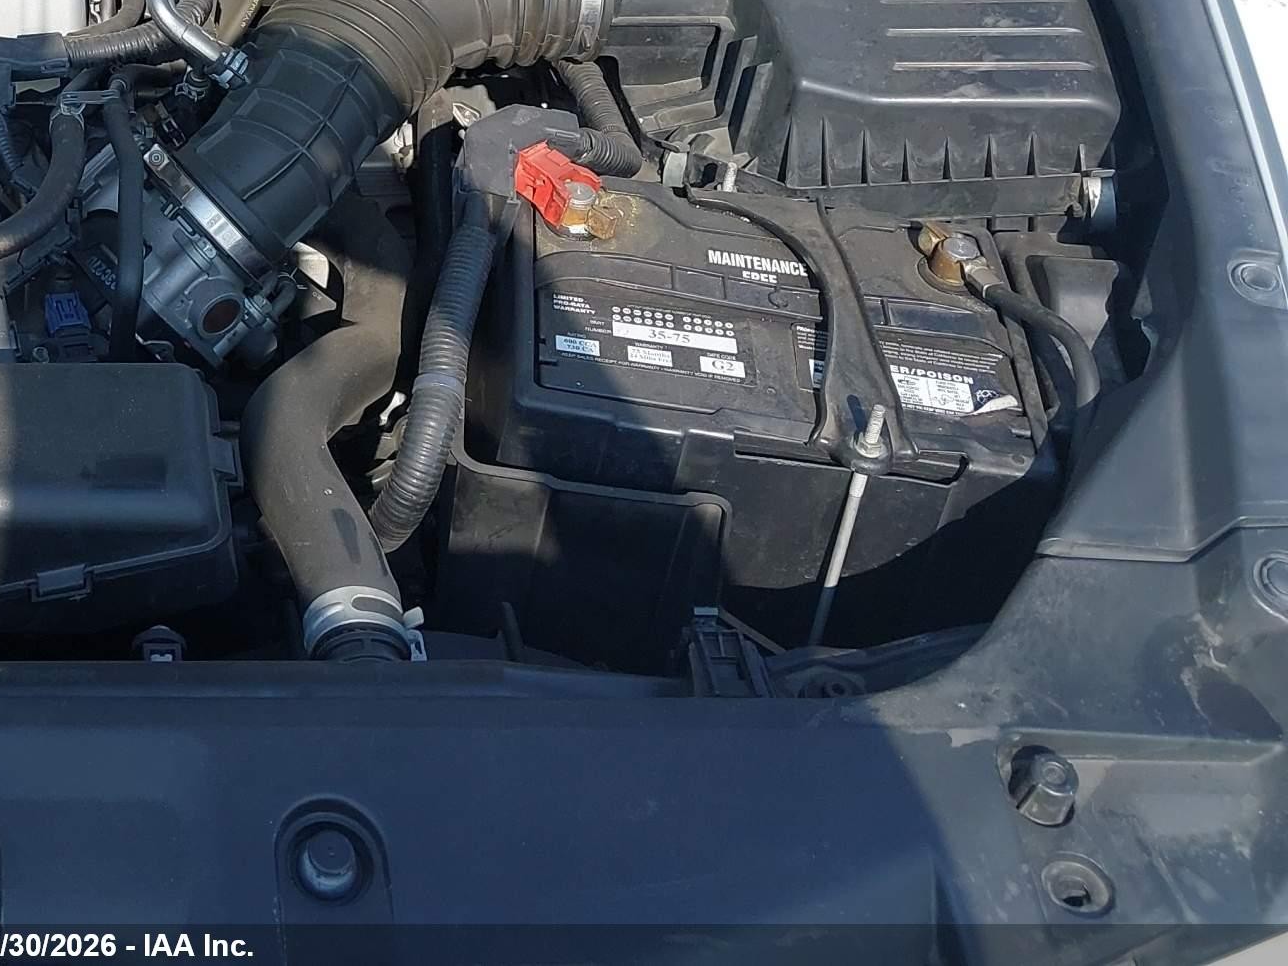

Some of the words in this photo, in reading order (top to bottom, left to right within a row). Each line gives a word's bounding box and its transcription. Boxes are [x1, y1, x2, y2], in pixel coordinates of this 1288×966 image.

[707, 249, 808, 277] MAINTENANCE
[647, 329, 691, 344] 35-75
[711, 359, 736, 372] G2
